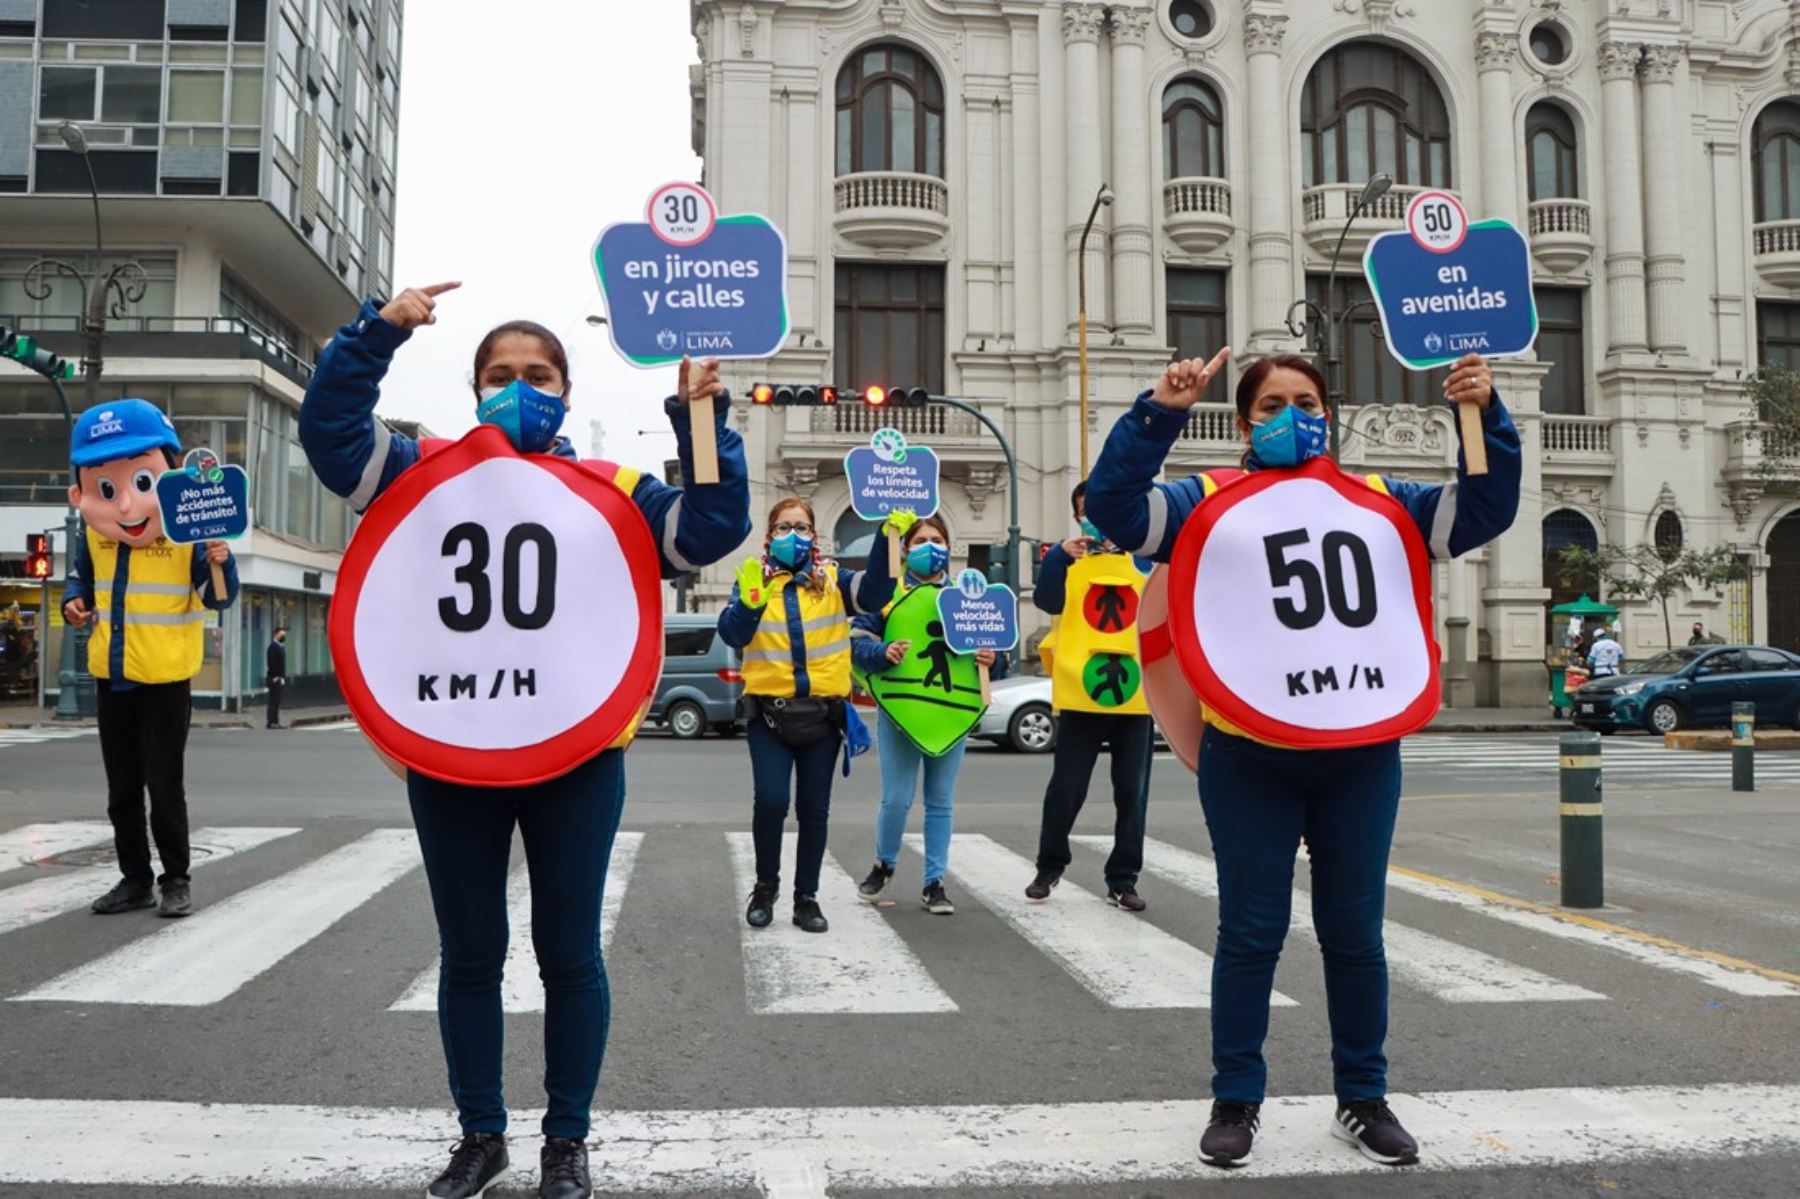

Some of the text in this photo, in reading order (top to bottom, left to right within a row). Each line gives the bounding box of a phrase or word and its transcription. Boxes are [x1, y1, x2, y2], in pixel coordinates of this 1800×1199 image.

[664, 195, 698, 223] 30
[1423, 203, 1452, 232] 50
[624, 254, 759, 284] en jirones
[1437, 265, 1467, 284] en
[642, 284, 745, 315] y calles
[1402, 286, 1507, 315] avenidas
[686, 337, 733, 349] LIMA
[1449, 337, 1490, 351] LIMA
[90, 423, 124, 438] LIMA
[873, 464, 917, 477] Respeta
[868, 475, 923, 487] los límites
[181, 484, 225, 502] ¡No más
[861, 487, 929, 499] de velocidad
[176, 496, 233, 512] accidentes
[175, 505, 237, 524] de tránsito!
[204, 527, 228, 536] LIMA
[438, 521, 558, 632] 30
[1263, 527, 1378, 630] 50
[961, 600, 995, 609] Menos
[953, 610, 1005, 622] velocidad,
[955, 621, 1005, 631] más vidas
[418, 668, 536, 701] KM/H
[1286, 663, 1384, 696] KM/H
